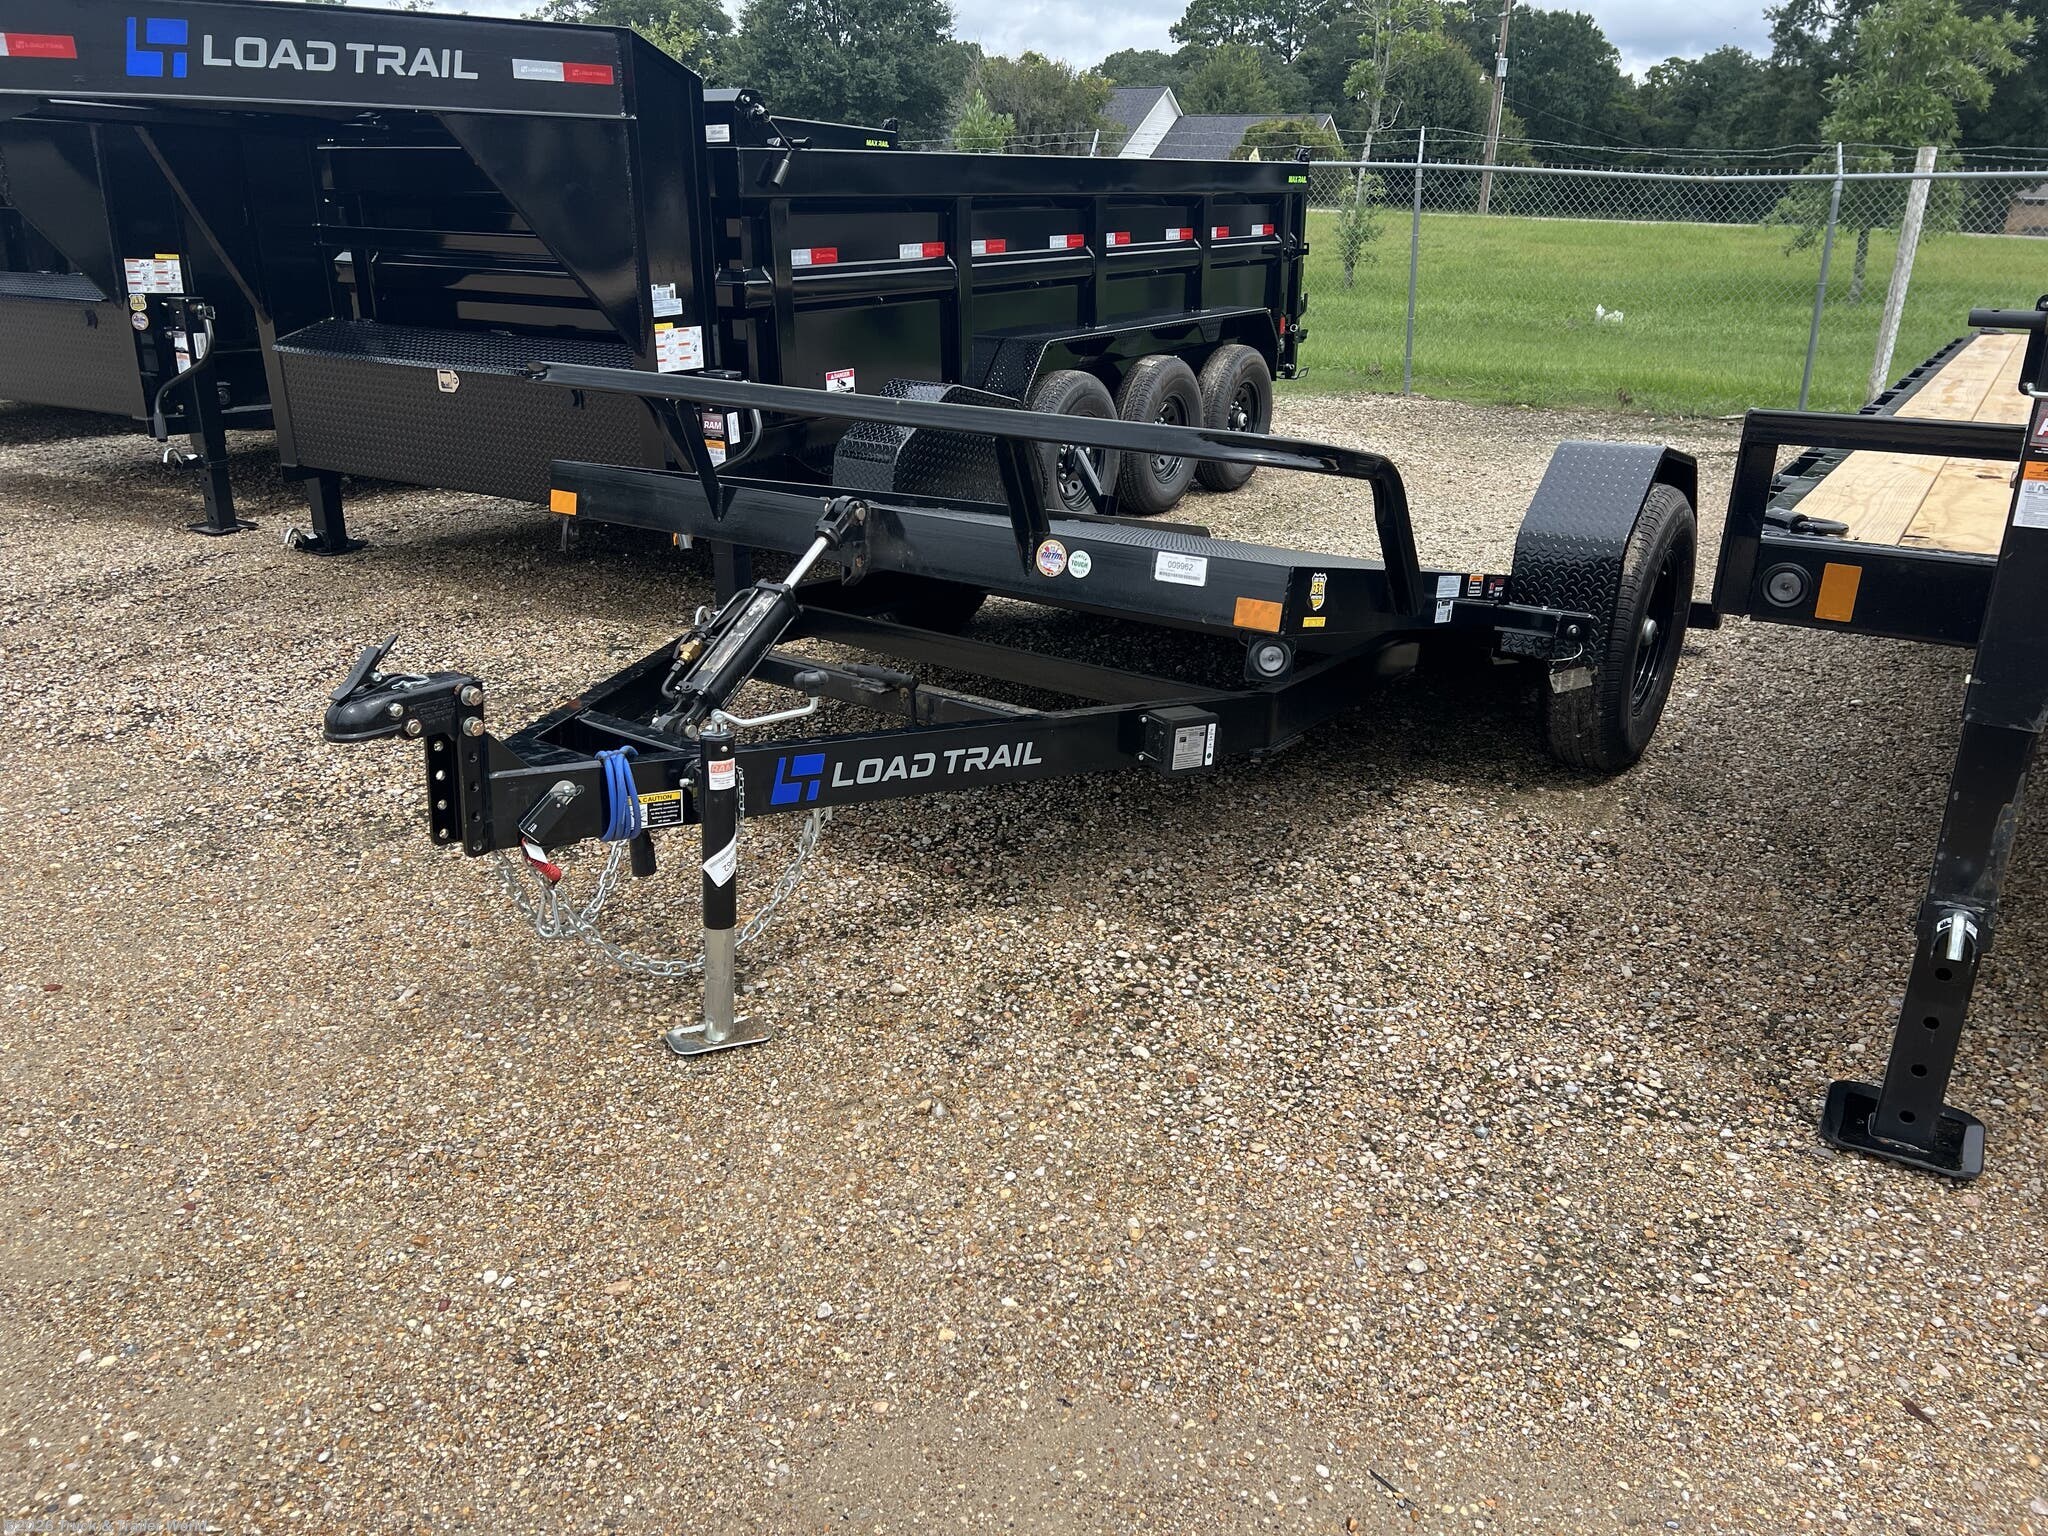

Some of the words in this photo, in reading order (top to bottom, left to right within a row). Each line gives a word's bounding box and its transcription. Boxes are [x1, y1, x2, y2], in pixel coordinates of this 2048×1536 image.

[203, 34, 337, 71] LOAD
[346, 42, 479, 80] TRAIL
[703, 420, 722, 430] RAM
[831, 752, 936, 788] LOAD
[943, 741, 1042, 774] TRAIL
[643, 794, 672, 803] CAUTION
